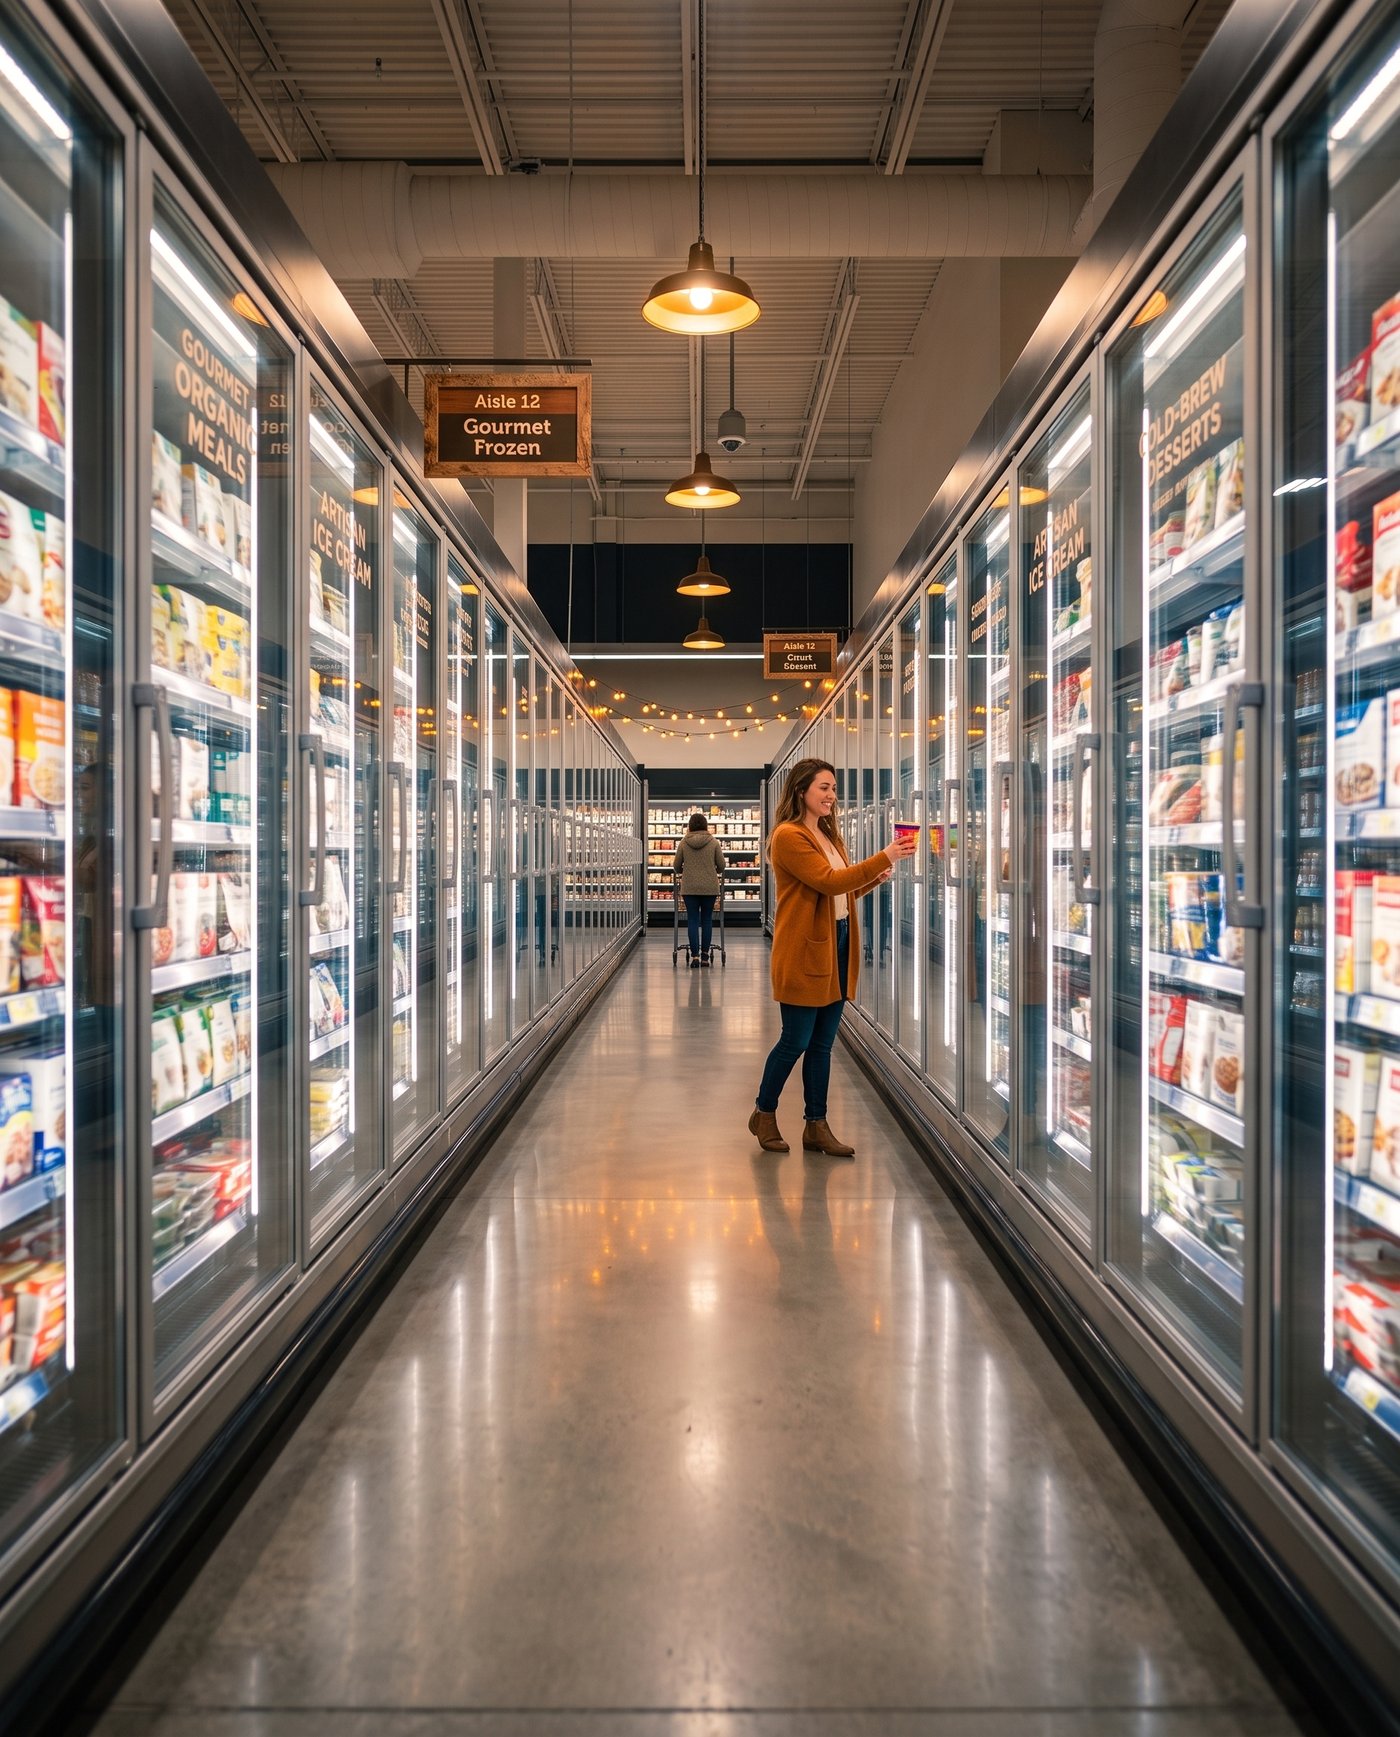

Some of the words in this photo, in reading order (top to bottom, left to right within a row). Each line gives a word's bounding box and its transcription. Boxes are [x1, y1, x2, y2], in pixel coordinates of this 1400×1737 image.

[181, 328, 249, 410] GOURMET
[474, 394, 516, 409] Aisle
[521, 394, 541, 409] 12
[175, 361, 257, 456] ORGANIC
[463, 417, 552, 435] Gourmet
[1138, 353, 1227, 459] COLD-BREW
[187, 412, 246, 485] MEALS
[474, 438, 542, 456] Frozen
[1148, 401, 1222, 488] DESSERTS
[313, 518, 333, 559] ICE
[336, 538, 372, 590] CREAM
[320, 490, 366, 552] ARTISAN
[1033, 499, 1078, 561] ARSAN
[1029, 561, 1044, 596] ICE
